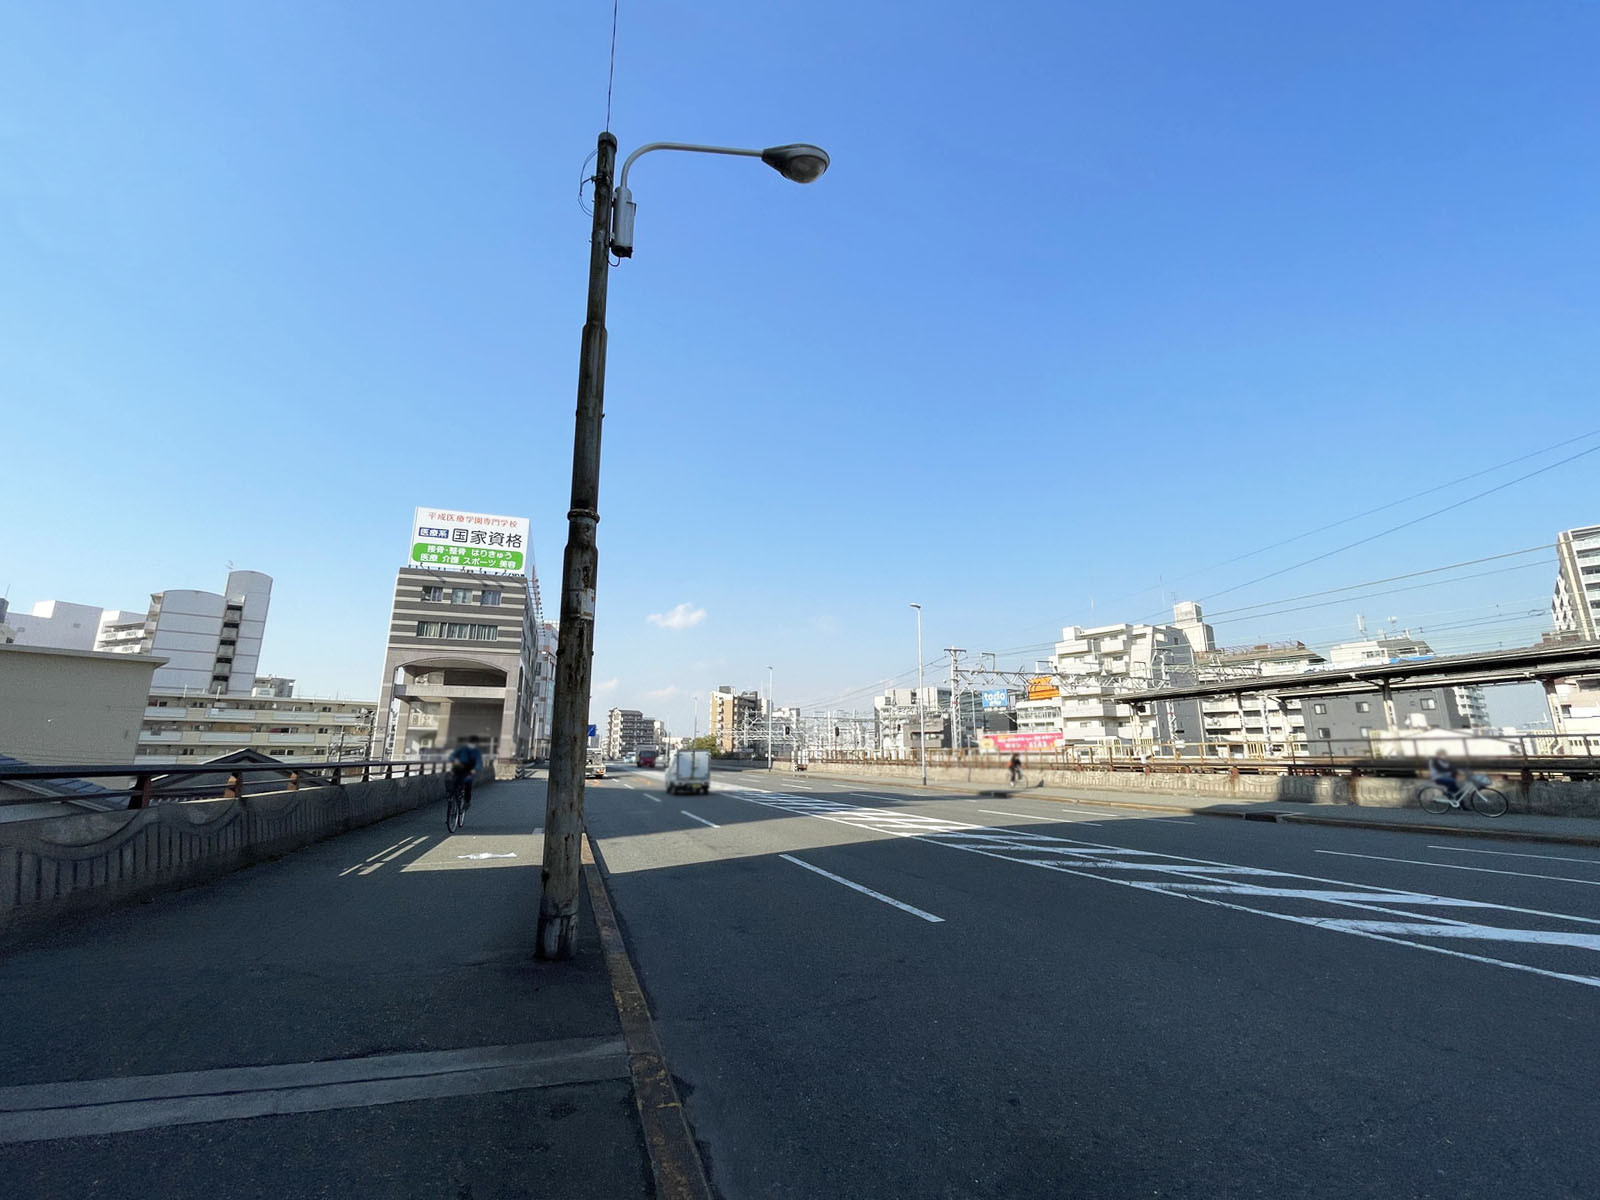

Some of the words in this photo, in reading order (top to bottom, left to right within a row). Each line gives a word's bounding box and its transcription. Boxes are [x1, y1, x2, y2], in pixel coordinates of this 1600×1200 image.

[428, 512, 518, 528] 平成医療学園専門学校
[452, 528, 522, 548] 国家資格
[420, 553, 438, 562] 医療
[442, 555, 459, 564] 介護
[463, 557, 496, 566] スポーツ
[499, 560, 516, 569] 美容
[471, 548, 513, 559] はりきゅう
